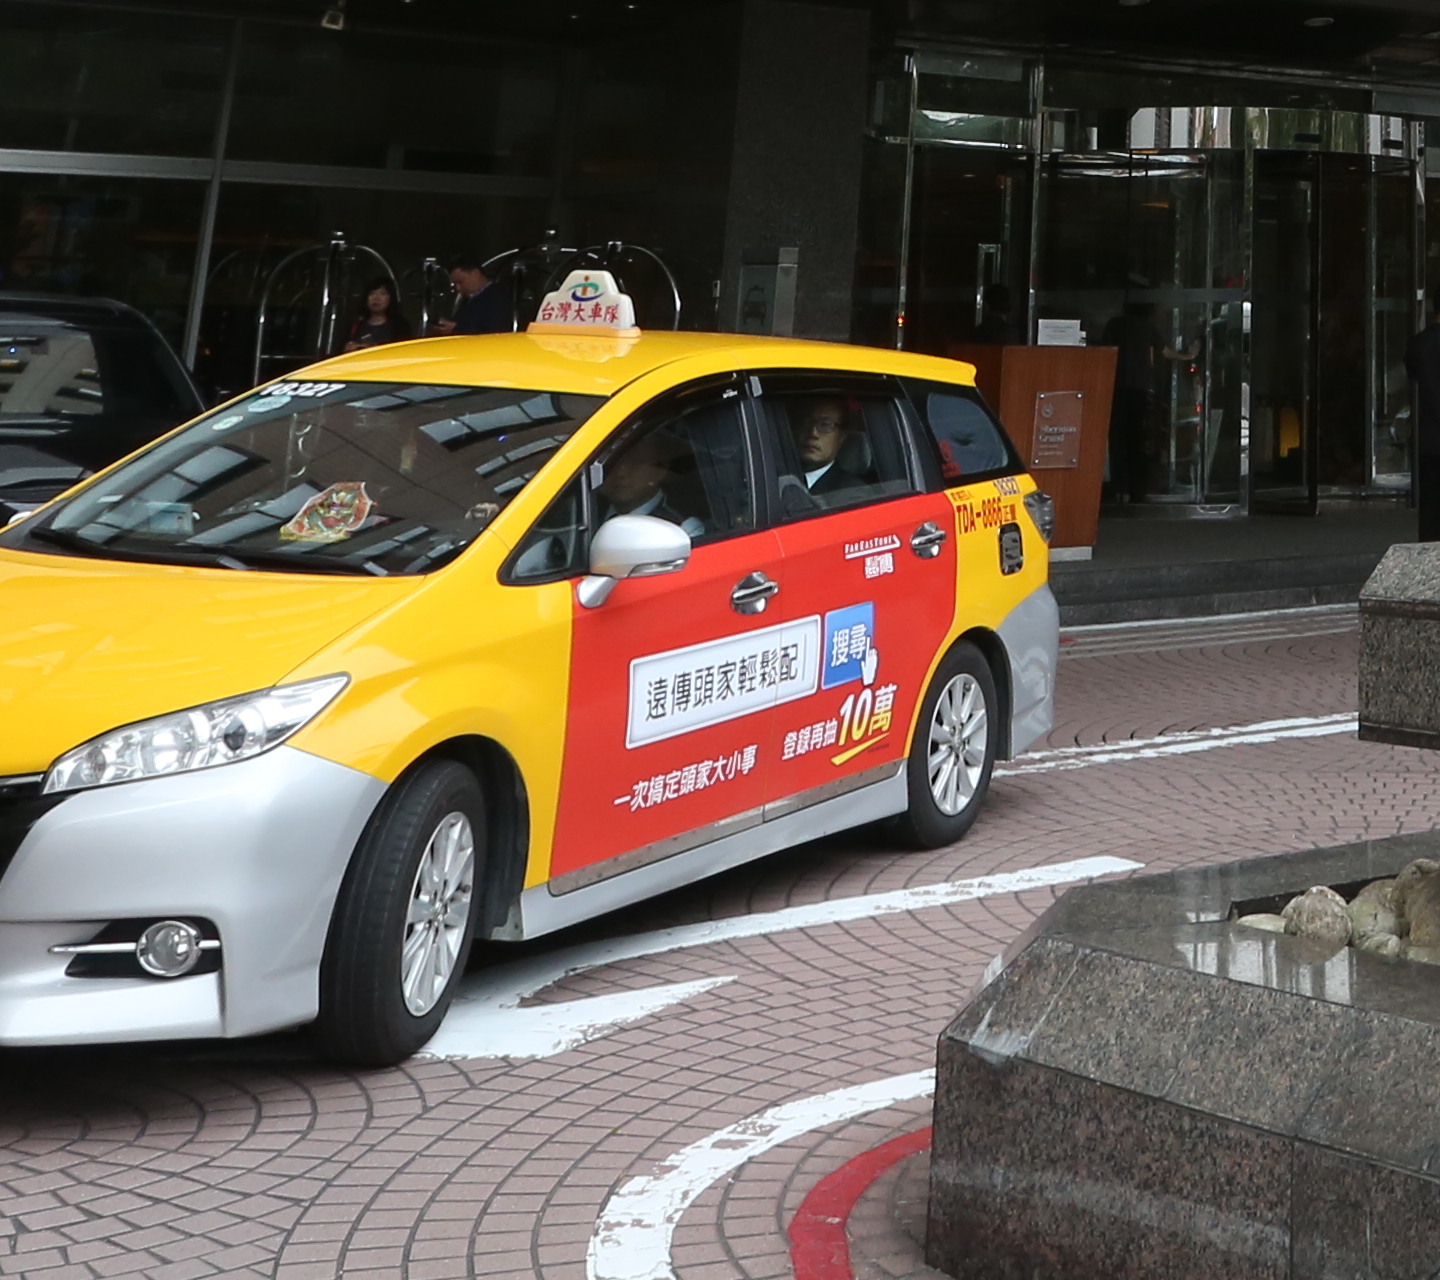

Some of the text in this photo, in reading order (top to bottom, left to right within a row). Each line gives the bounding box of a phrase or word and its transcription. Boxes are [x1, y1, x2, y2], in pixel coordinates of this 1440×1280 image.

[540, 300, 620, 324] 台灣大車隊
[830, 622, 868, 668] 搜尋
[645, 642, 799, 722] 遠傳頭家輕鬆配
[613, 743, 759, 813] 一次搞定頭家大小事
